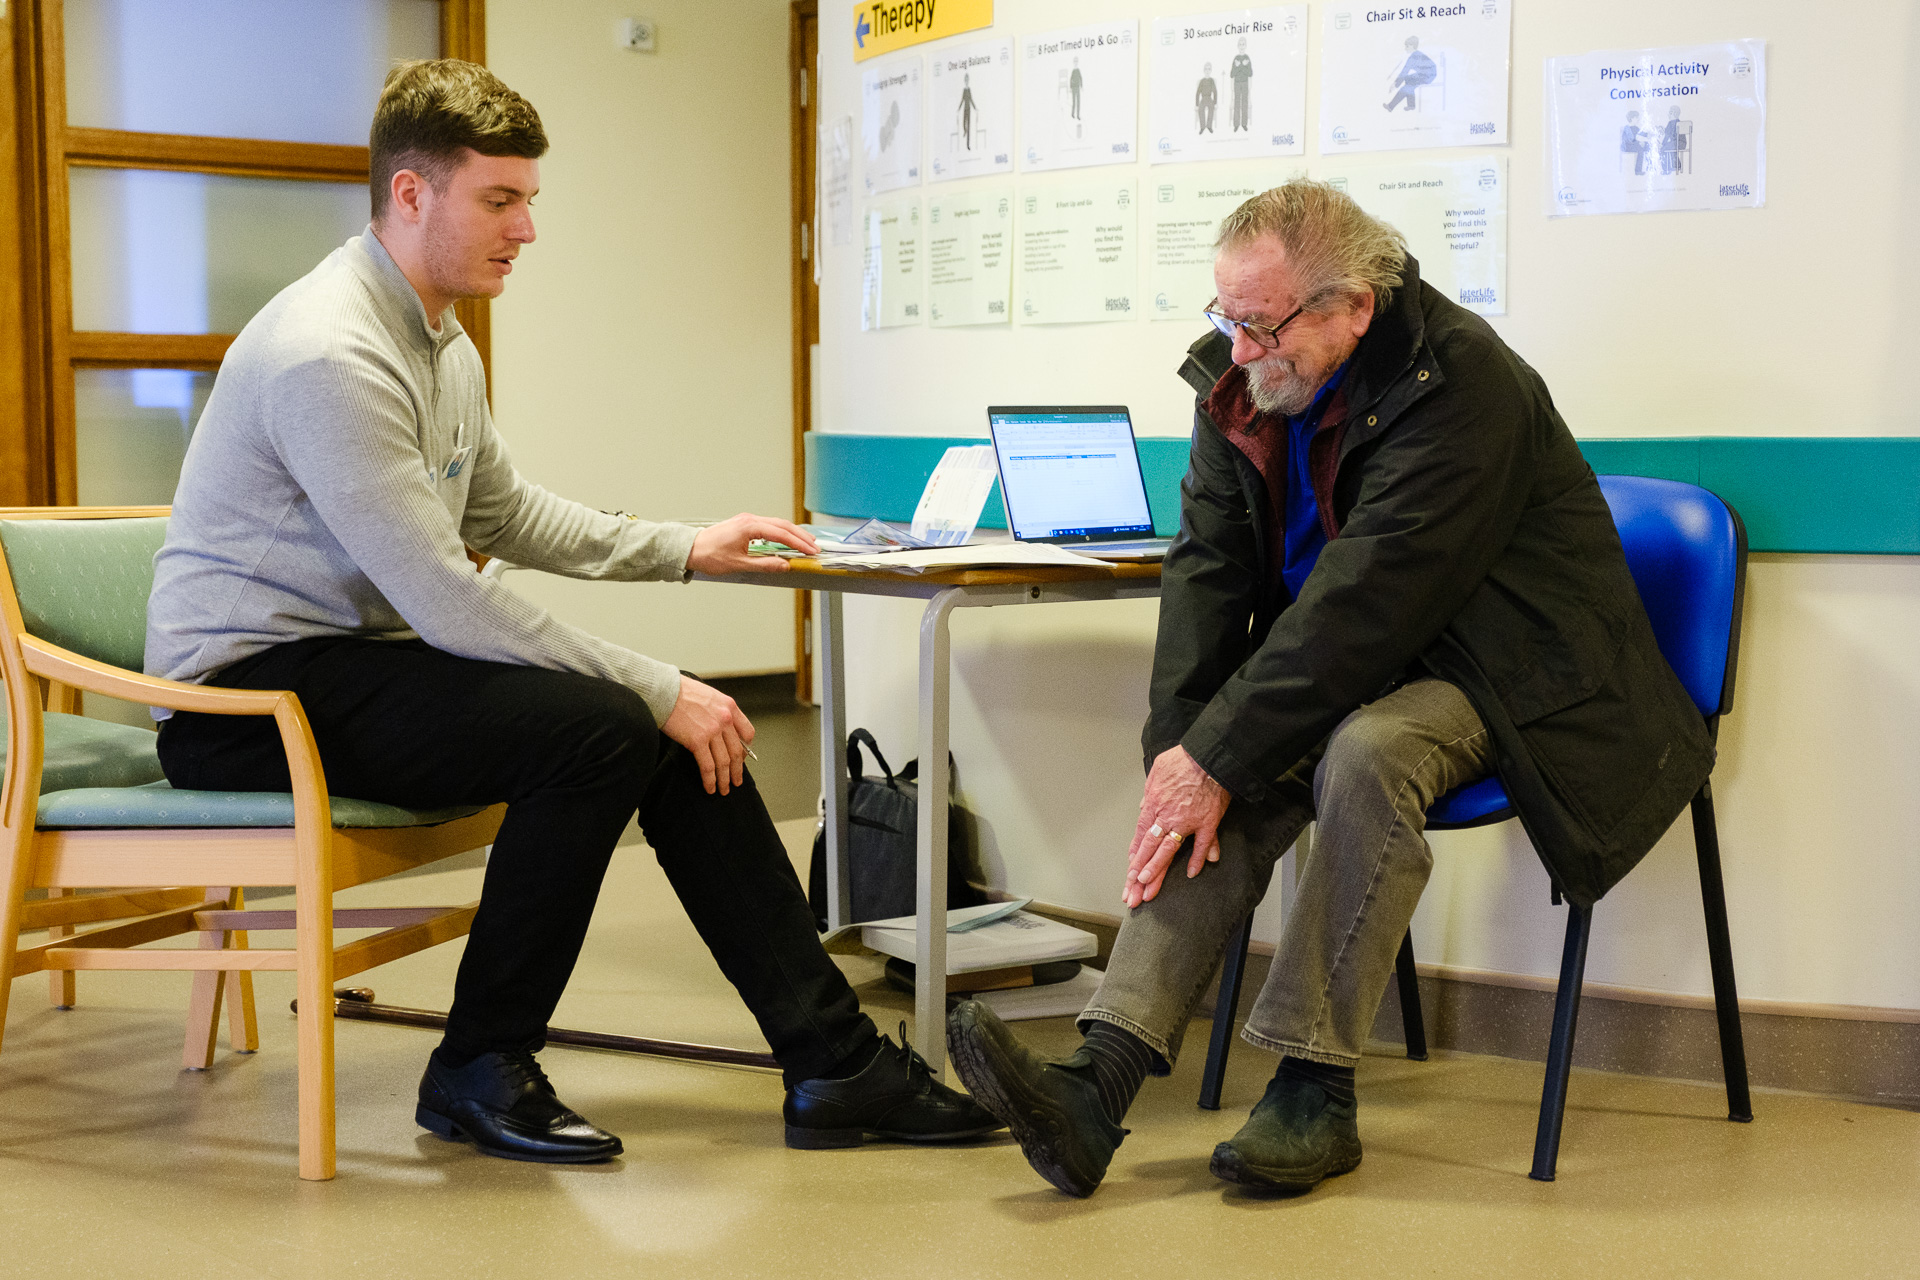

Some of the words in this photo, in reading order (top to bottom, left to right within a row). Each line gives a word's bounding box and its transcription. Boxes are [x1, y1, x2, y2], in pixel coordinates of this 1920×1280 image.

[872, 0, 936, 37] Therapy
[1366, 10, 1396, 23] Chair
[1398, 7, 1413, 20] Sit
[1416, 6, 1426, 18] &
[1430, 3, 1466, 17] Reach
[1184, 28, 1195, 39] 30
[1196, 27, 1222, 38] Second
[1224, 22, 1250, 35] Chair
[1252, 20, 1273, 32] Rise
[1038, 44, 1043, 55] 8
[1043, 43, 1059, 54] Foot
[1060, 38, 1082, 52] Timed
[1084, 37, 1095, 49] Up
[1097, 35, 1104, 46] &
[1106, 34, 1119, 45] Go
[959, 59, 968, 70] Leg
[968, 55, 991, 67] Balance
[1600, 64, 1653, 81] Physical
[1657, 61, 1709, 76] Activity
[1610, 84, 1699, 100] Conversation
[1397, 181, 1406, 189] Sit
[1407, 180, 1421, 188] and
[1422, 179, 1443, 188] Reach
[1205, 189, 1226, 198] Second
[1226, 188, 1241, 197] Chair
[1242, 188, 1255, 196] Rise
[1445, 209, 1461, 218] Why
[1462, 208, 1486, 216] would
[1443, 221, 1456, 229] you
[1458, 220, 1472, 228] find
[1445, 230, 1484, 239] movement
[1450, 241, 1479, 251] helpful?
[1460, 287, 1495, 297] laterLife
